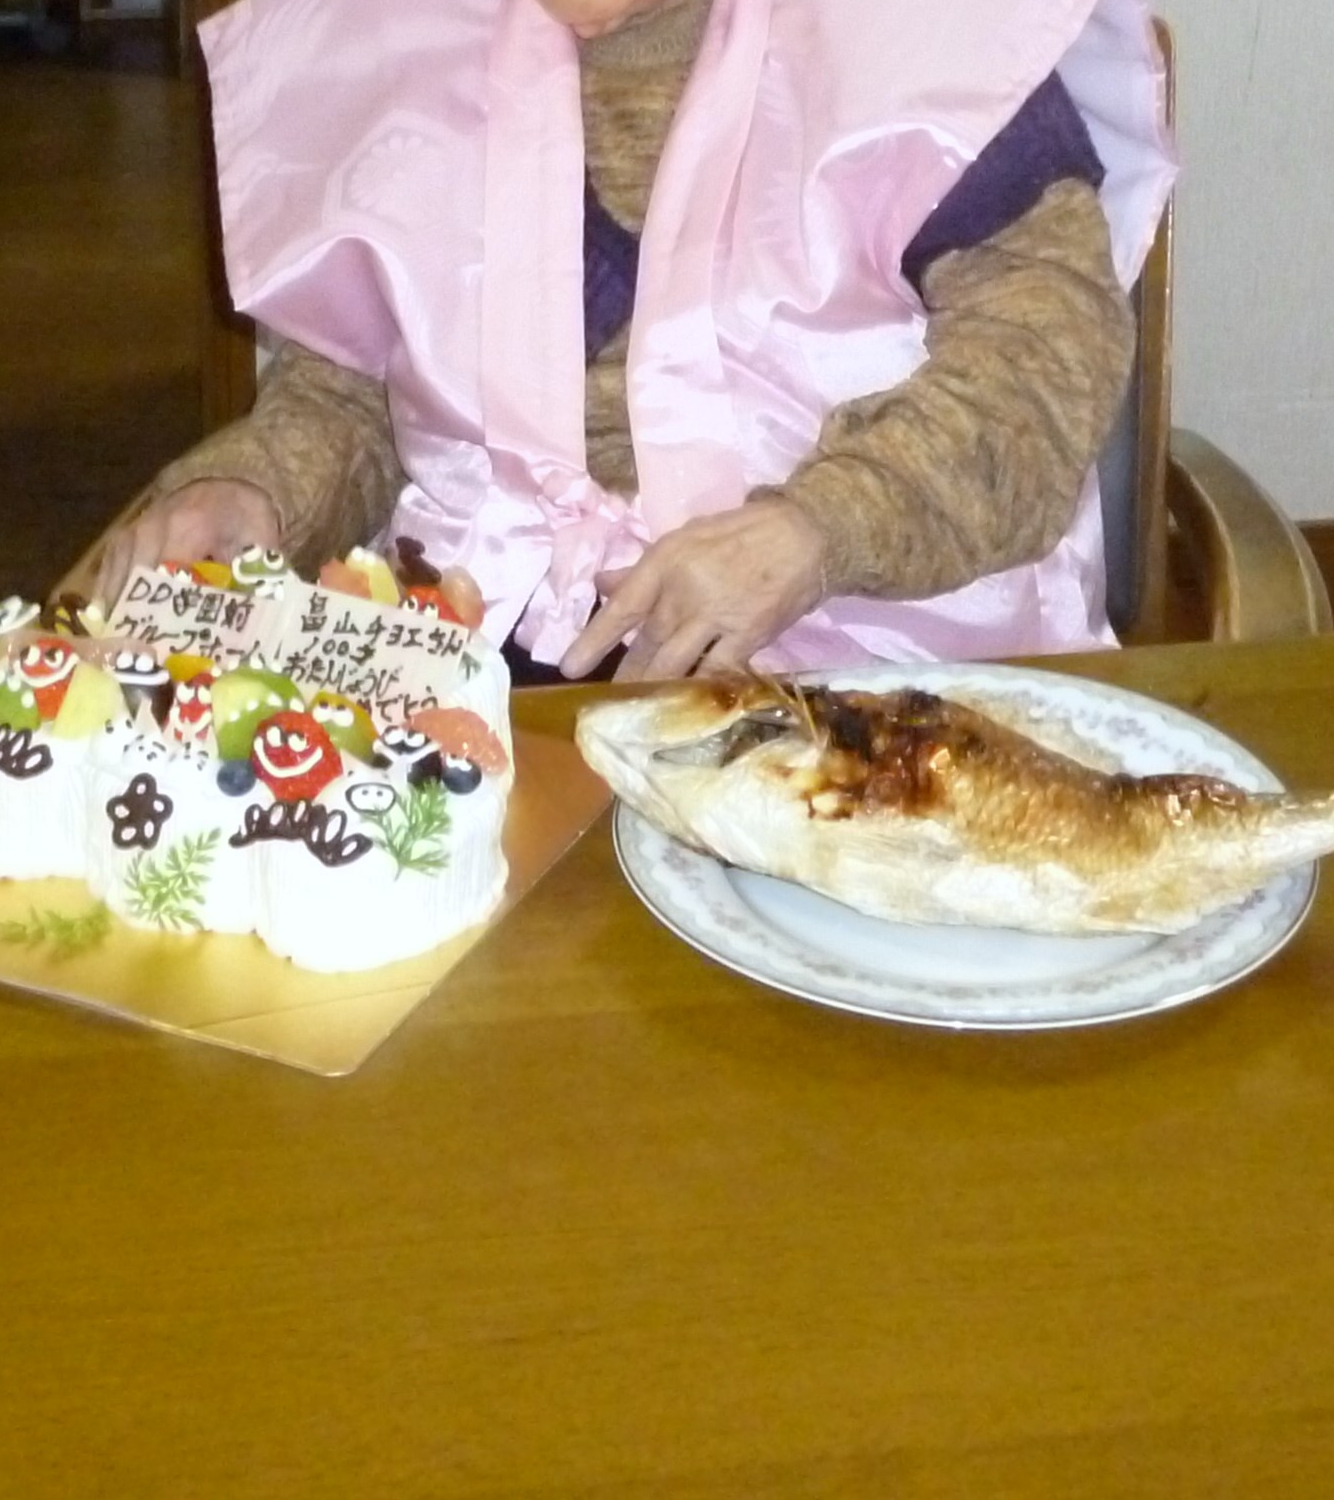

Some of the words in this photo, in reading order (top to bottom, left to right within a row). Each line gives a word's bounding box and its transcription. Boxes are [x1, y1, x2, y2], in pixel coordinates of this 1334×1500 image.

[282, 651, 405, 697] おたんじょうび
